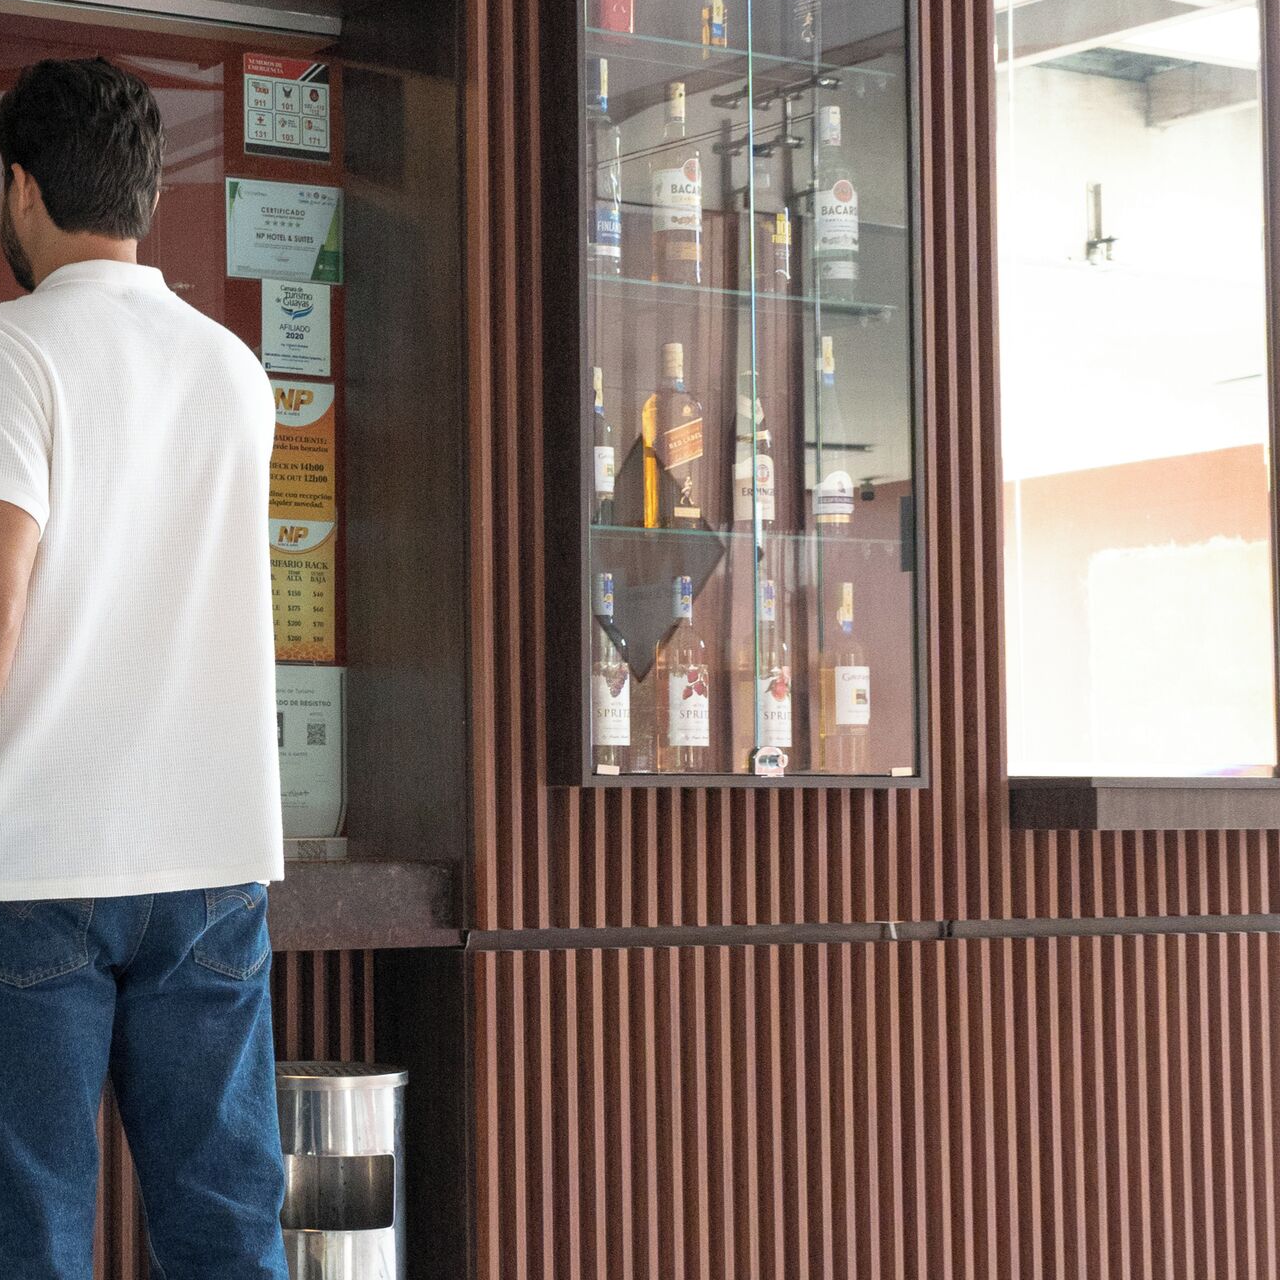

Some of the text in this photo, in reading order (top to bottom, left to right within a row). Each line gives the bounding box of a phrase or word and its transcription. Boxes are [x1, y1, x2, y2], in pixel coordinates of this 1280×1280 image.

[254, 99, 266, 107] 911
[281, 102, 293, 110] 101
[255, 130, 267, 138] 131
[308, 136, 320, 145] 171
[260, 206, 306, 216] CERTIFICADO
[266, 233, 286, 242] HOTEL
[294, 235, 314, 244] SUITES
[284, 291, 313, 301] Turismo
[282, 297, 310, 308] Guayas
[279, 324, 310, 333] AFILIADO
[286, 332, 304, 340] 2020
[275, 387, 314, 411] NP
[300, 463, 324, 472] 14h00
[271, 473, 286, 481] ECK
[303, 474, 328, 483] 12h00
[278, 525, 309, 543] NP
[271, 559, 329, 570] RIFARIO RACK
[310, 576, 326, 584] BAJA
